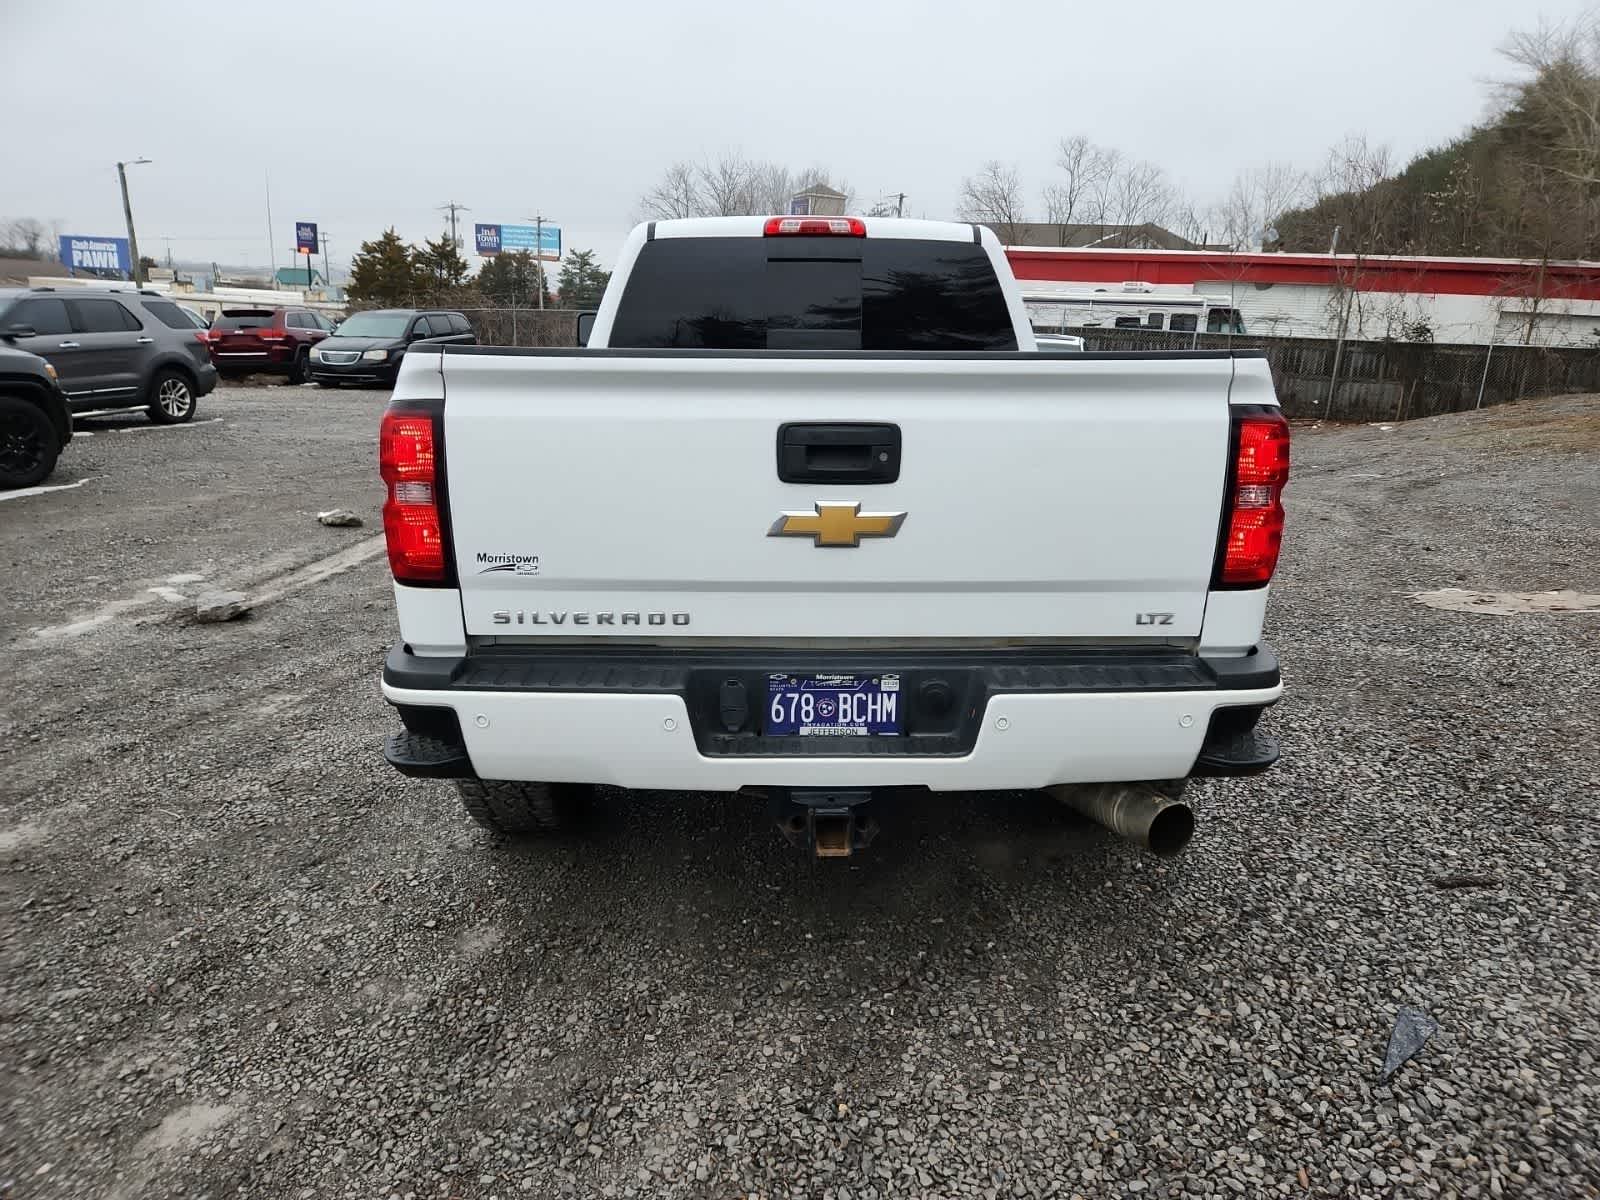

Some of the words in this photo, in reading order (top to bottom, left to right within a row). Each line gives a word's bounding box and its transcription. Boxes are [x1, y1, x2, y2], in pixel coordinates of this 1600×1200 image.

[477, 234, 499, 244] Town
[72, 250, 120, 269] PAWN
[476, 553, 539, 564] Morristown
[493, 610, 690, 625] SILVERADO
[1136, 612, 1176, 625] LTZ
[815, 673, 854, 681] Morristown
[771, 693, 815, 723] 678
[838, 693, 896, 723] BCHM
[808, 728, 858, 736] JEFFERSON
